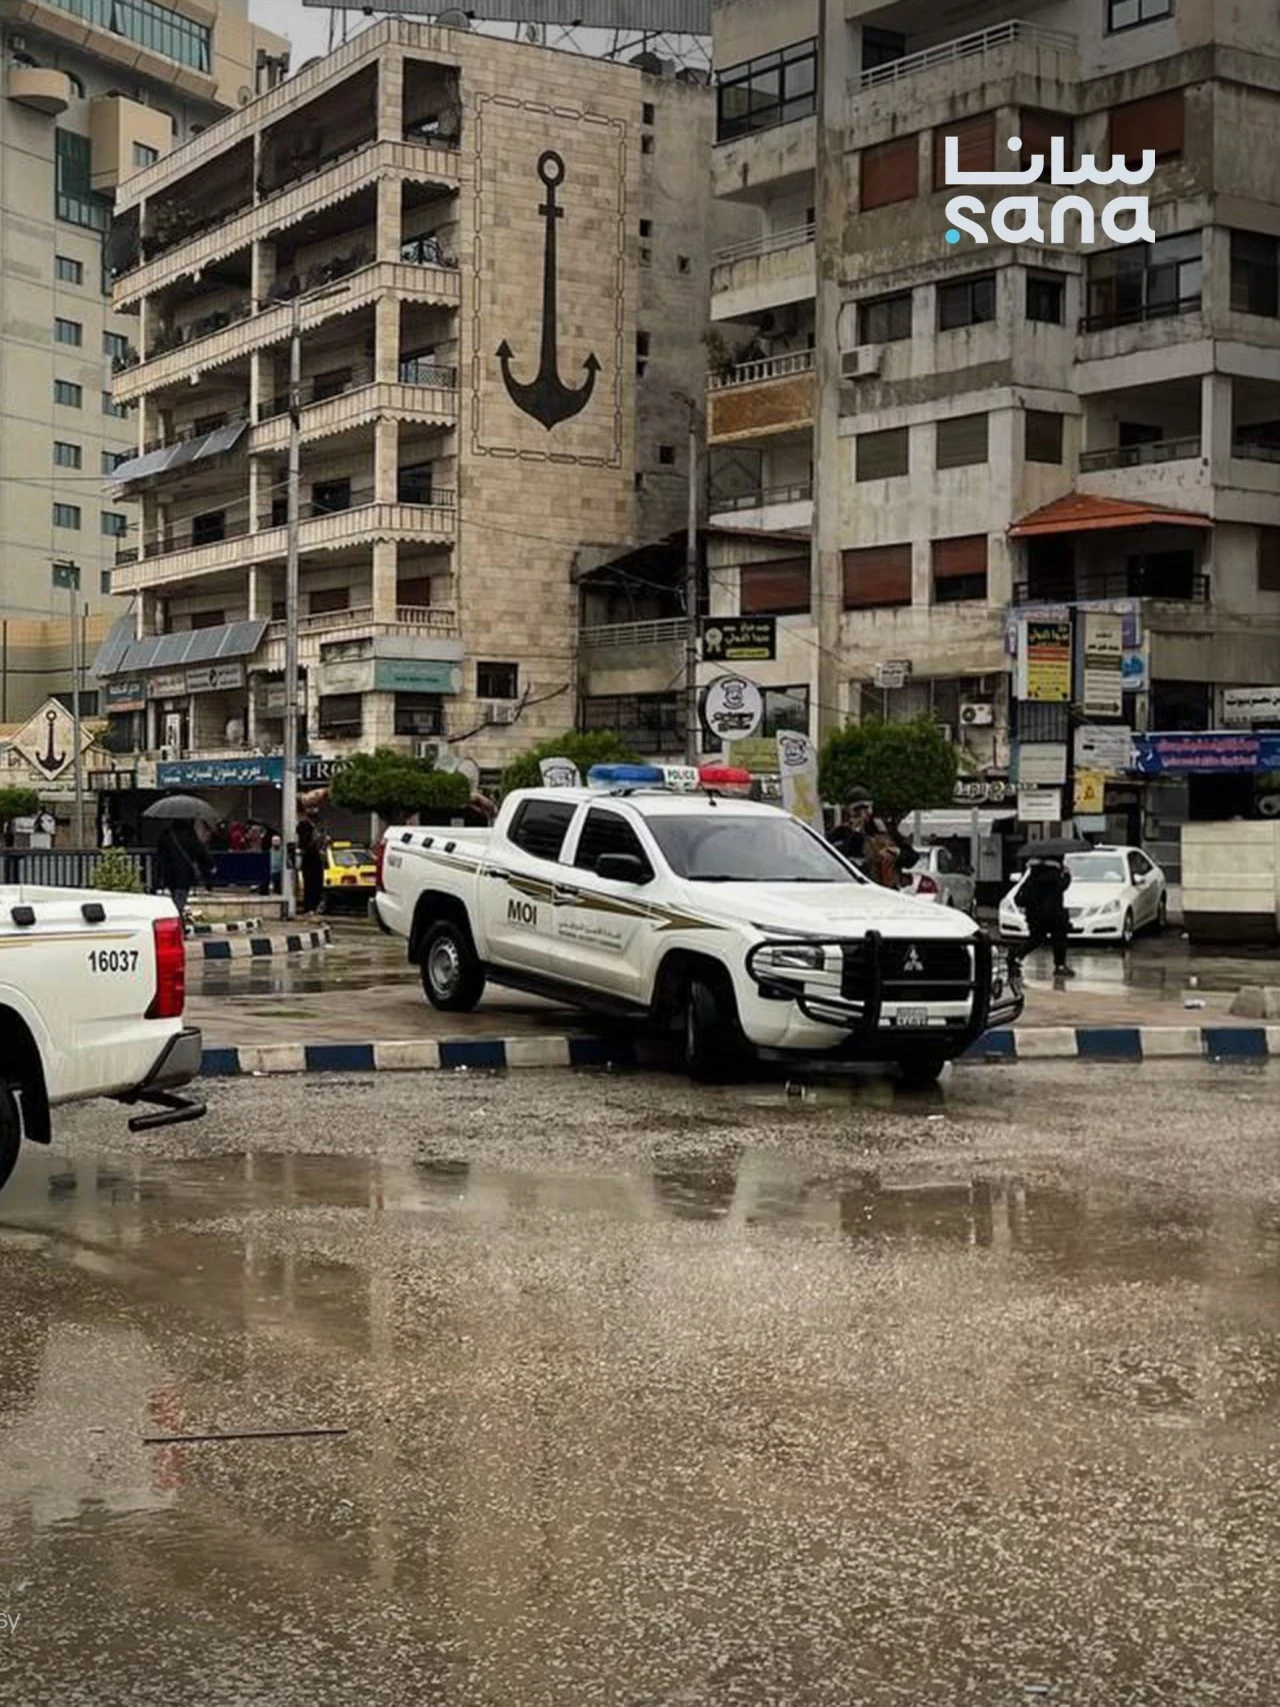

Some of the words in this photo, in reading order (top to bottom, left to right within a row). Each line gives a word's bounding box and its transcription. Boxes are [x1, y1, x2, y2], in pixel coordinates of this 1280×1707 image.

[668, 768, 696, 780] POLICE
[507, 899, 537, 925] MOI
[88, 950, 139, 972] 16037
